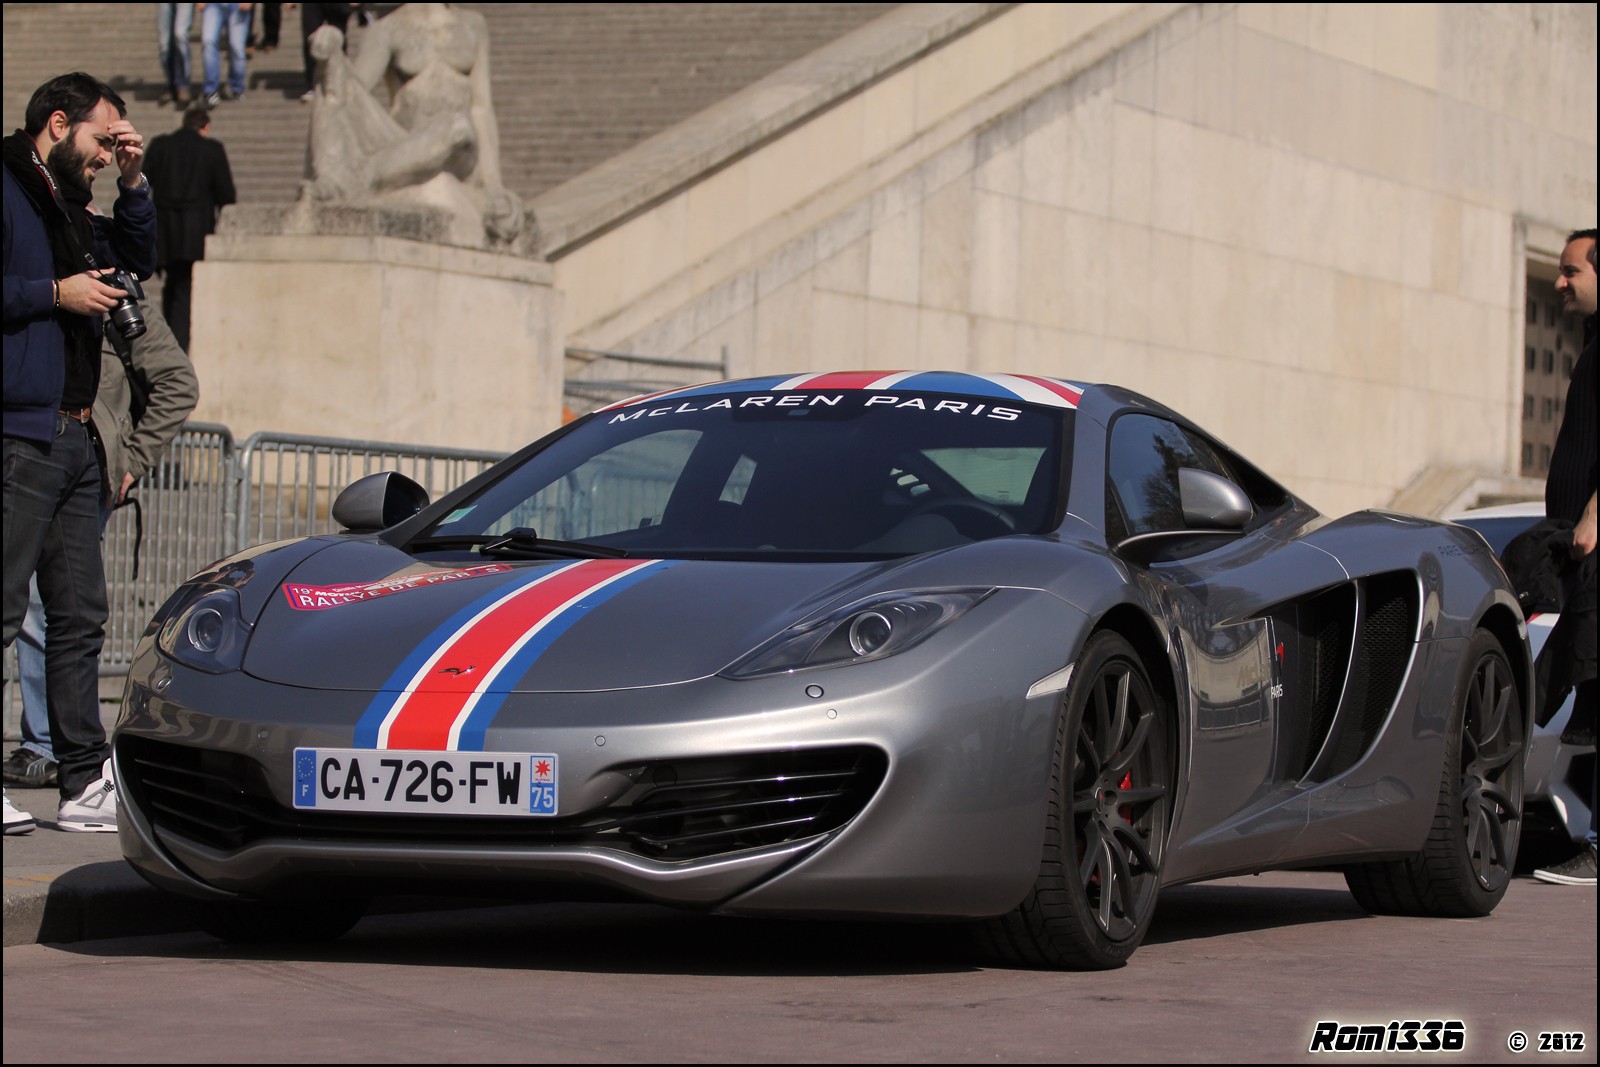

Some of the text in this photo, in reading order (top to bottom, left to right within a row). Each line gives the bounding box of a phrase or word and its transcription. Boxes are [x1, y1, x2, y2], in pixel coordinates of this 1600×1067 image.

[864, 396, 1022, 421] PARIS
[300, 590, 380, 606] RALLYE
[389, 581, 418, 591] DE
[426, 567, 499, 583] PARIS
[302, 784, 309, 797] F
[321, 757, 521, 804] CA-726-FW
[532, 787, 553, 808] 75
